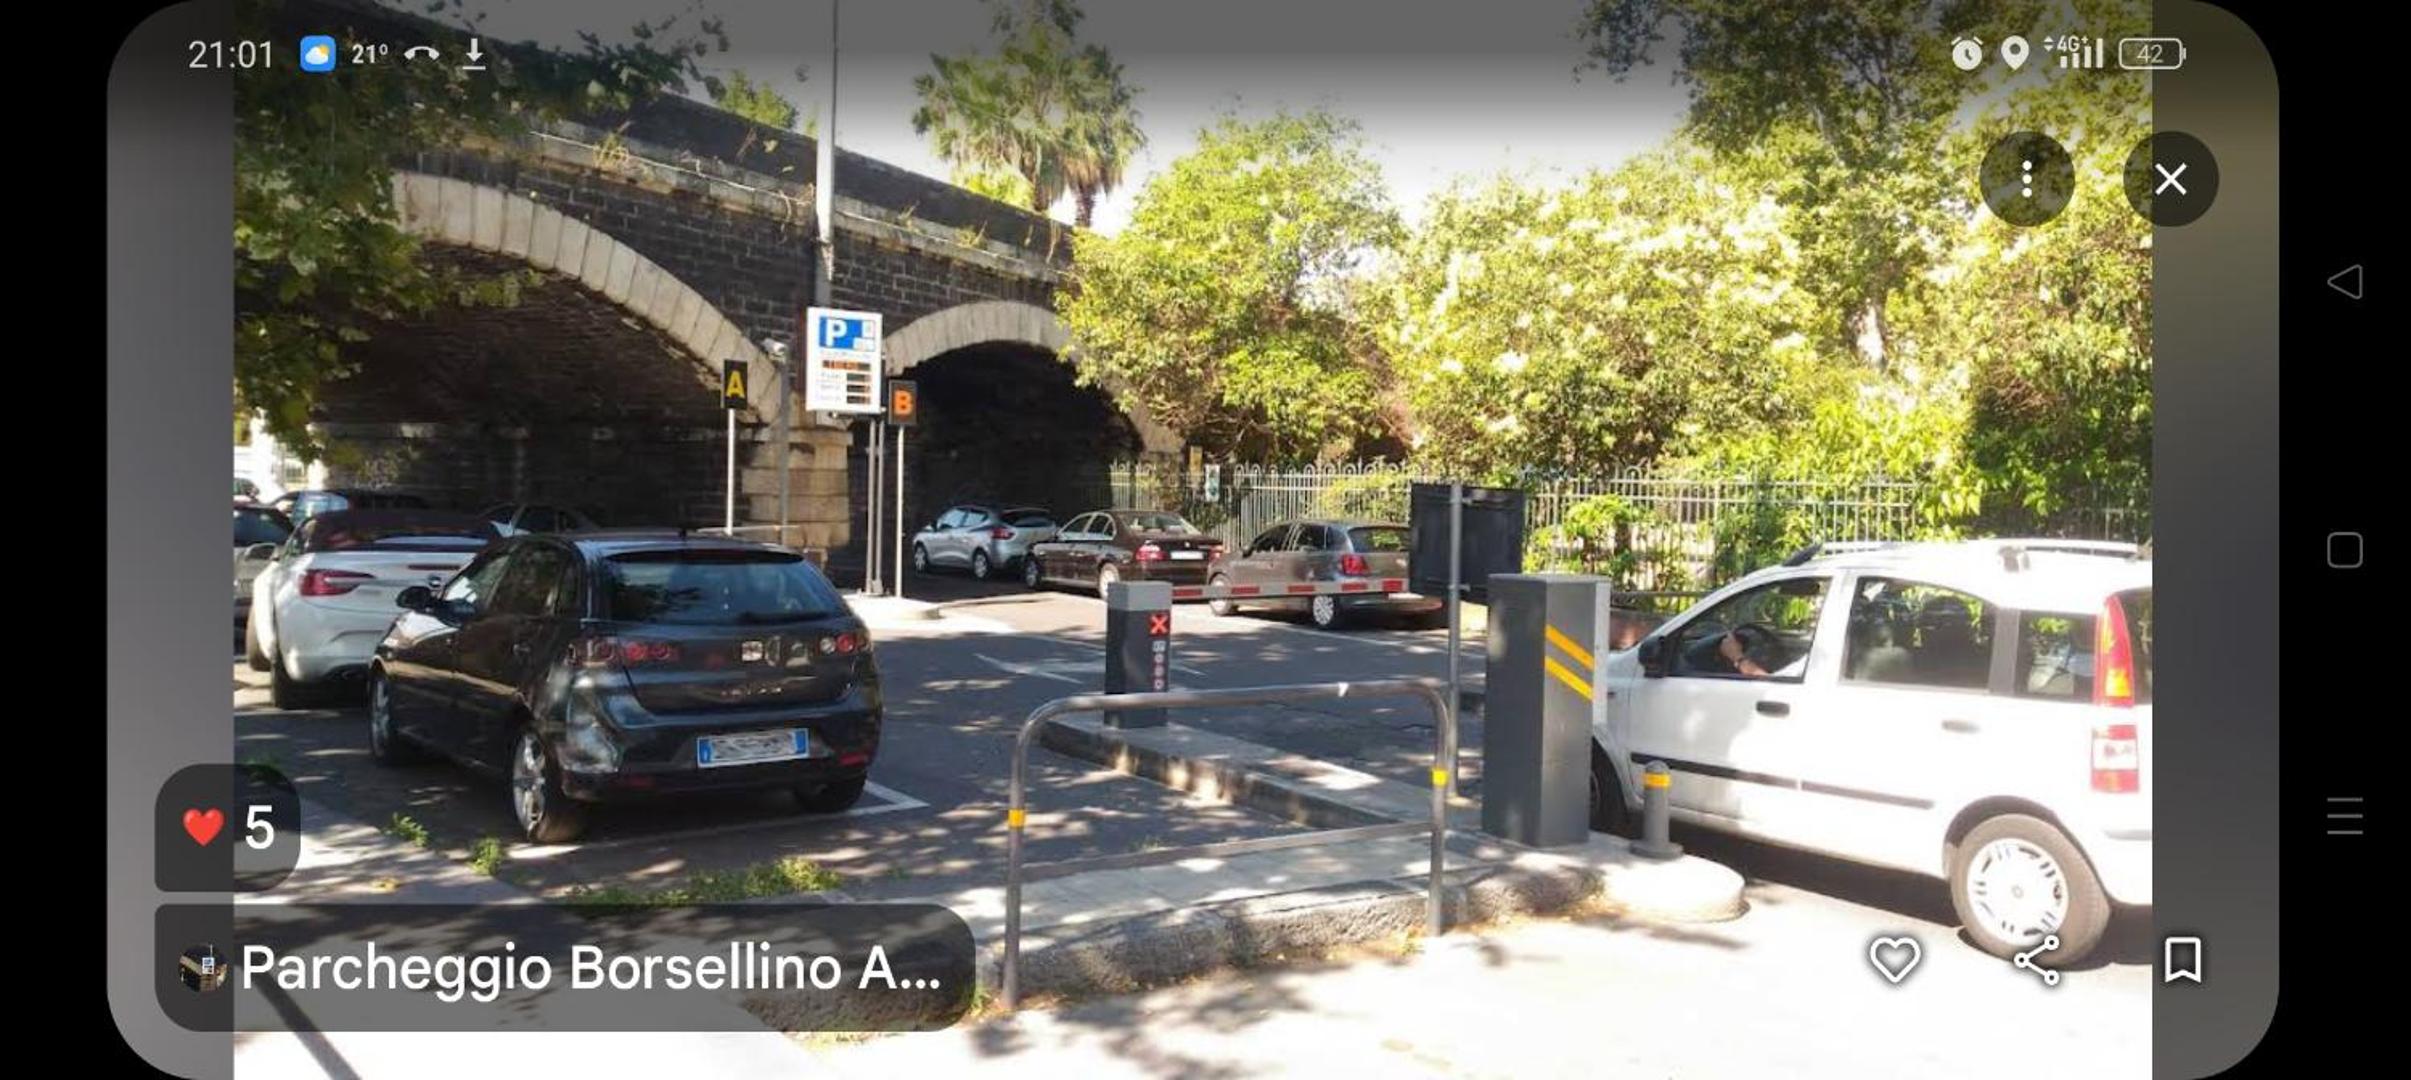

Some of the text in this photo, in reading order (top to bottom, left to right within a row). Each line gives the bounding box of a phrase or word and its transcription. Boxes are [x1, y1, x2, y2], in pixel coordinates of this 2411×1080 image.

[825, 319, 847, 348] P
[726, 370, 745, 398] A
[893, 388, 913, 416] B
